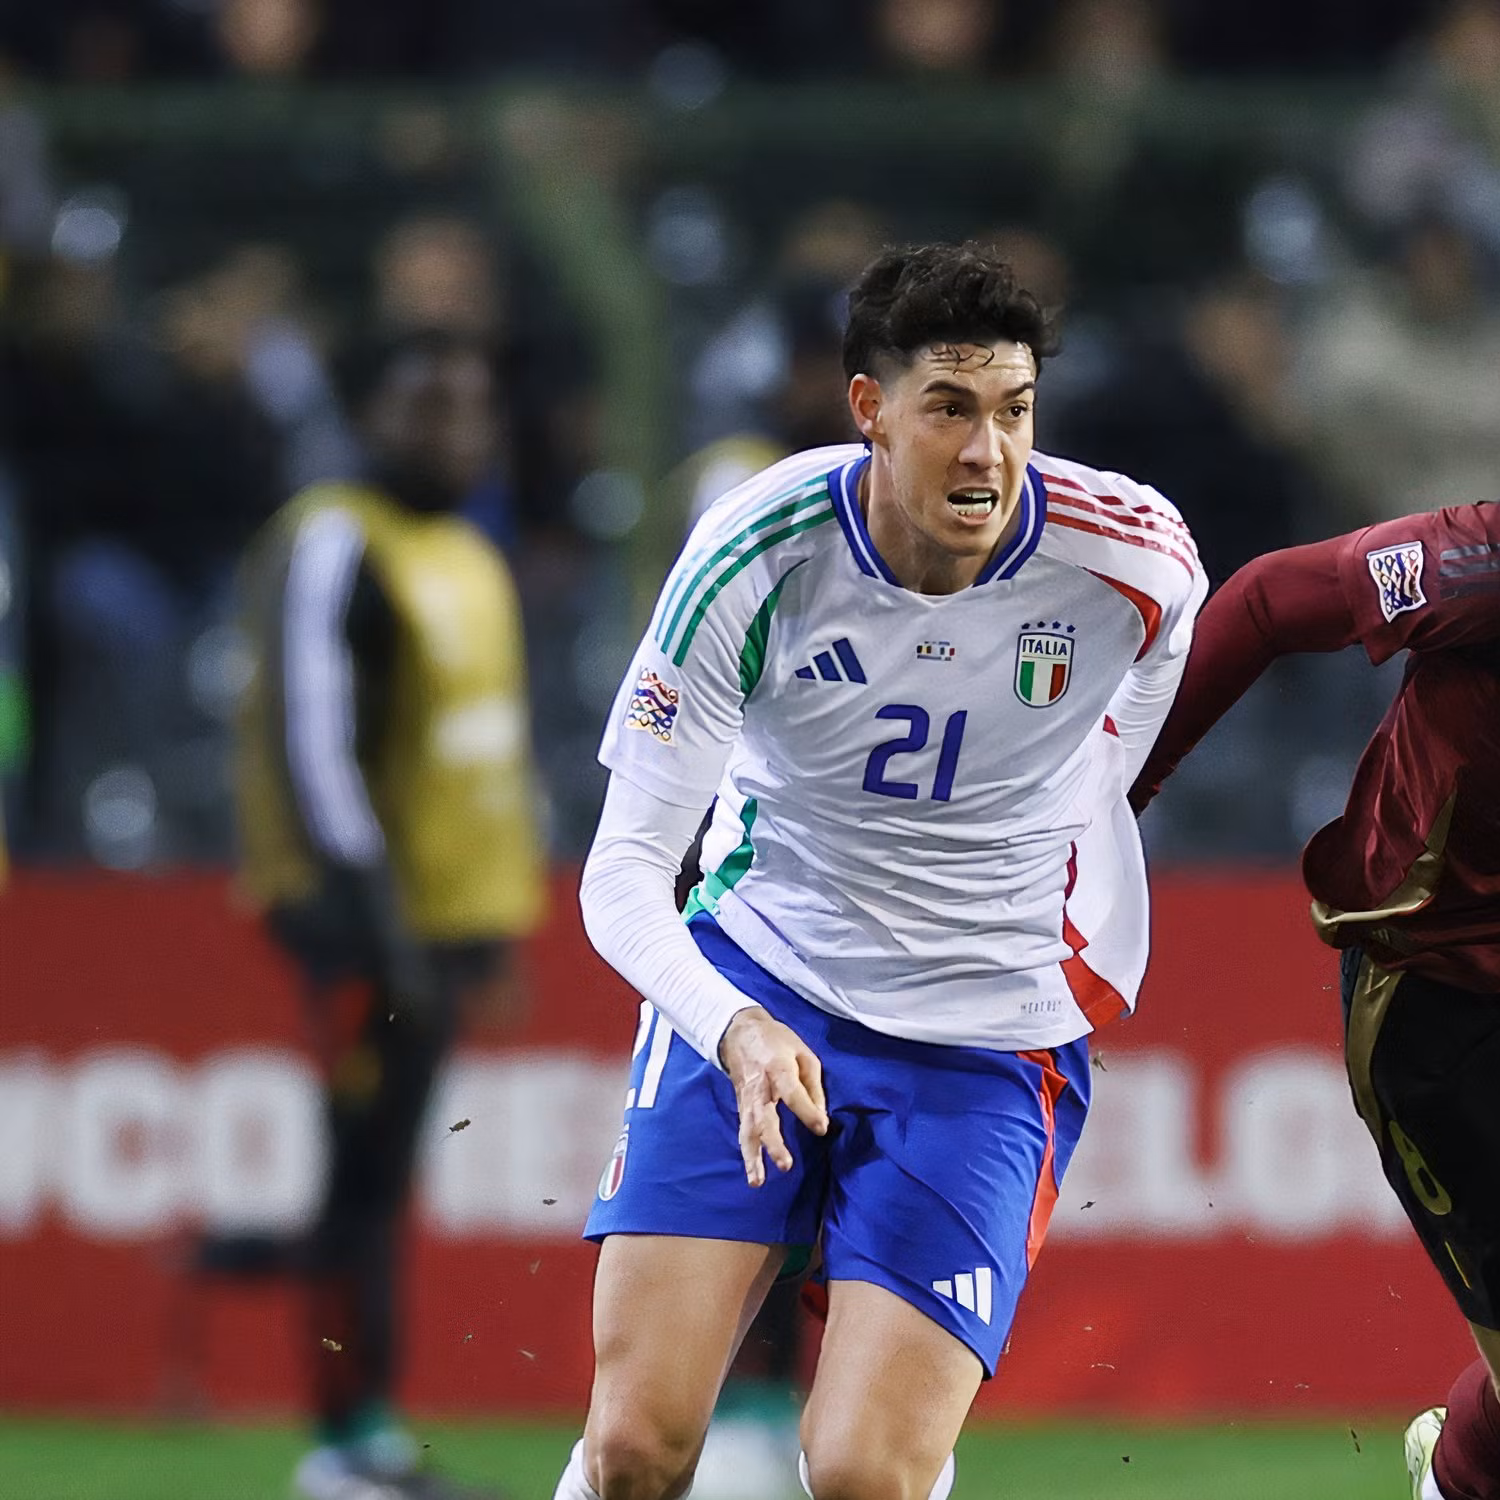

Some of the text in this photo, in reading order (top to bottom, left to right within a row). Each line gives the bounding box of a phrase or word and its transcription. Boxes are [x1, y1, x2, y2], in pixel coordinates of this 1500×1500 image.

[1022, 638, 1068, 656] ITALIA
[862, 703, 968, 802] 21
[1388, 1119, 1452, 1216] 8
